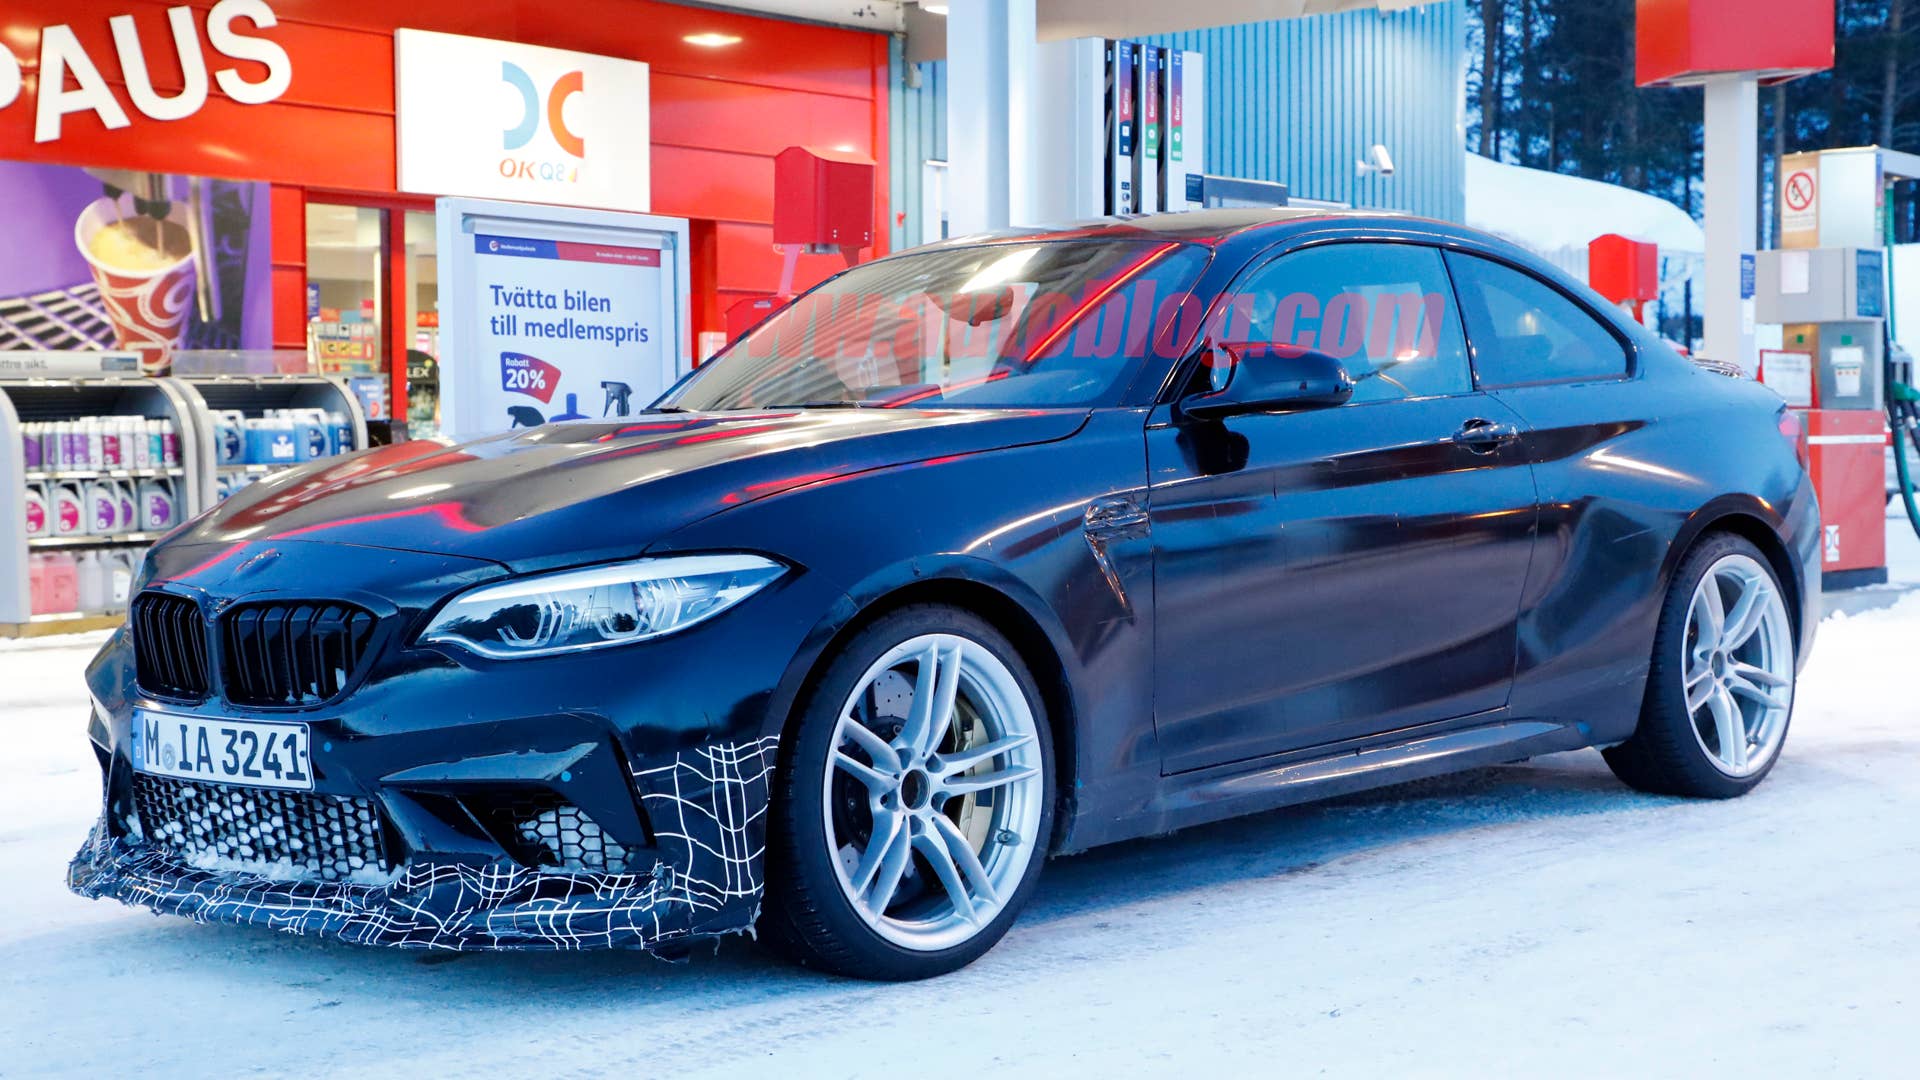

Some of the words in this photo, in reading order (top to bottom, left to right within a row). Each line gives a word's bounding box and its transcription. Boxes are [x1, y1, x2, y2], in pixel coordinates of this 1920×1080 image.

[0, 0, 292, 143] AUS
[489, 285, 557, 310] Tvätta
[564, 289, 611, 313] bilen
[490, 314, 517, 337] till
[524, 317, 649, 347] medlemspris
[505, 357, 531, 367] Rabatt
[505, 369, 546, 390] 20%
[145, 718, 160, 767] M
[179, 724, 215, 775] IA
[221, 728, 307, 782] 3241
